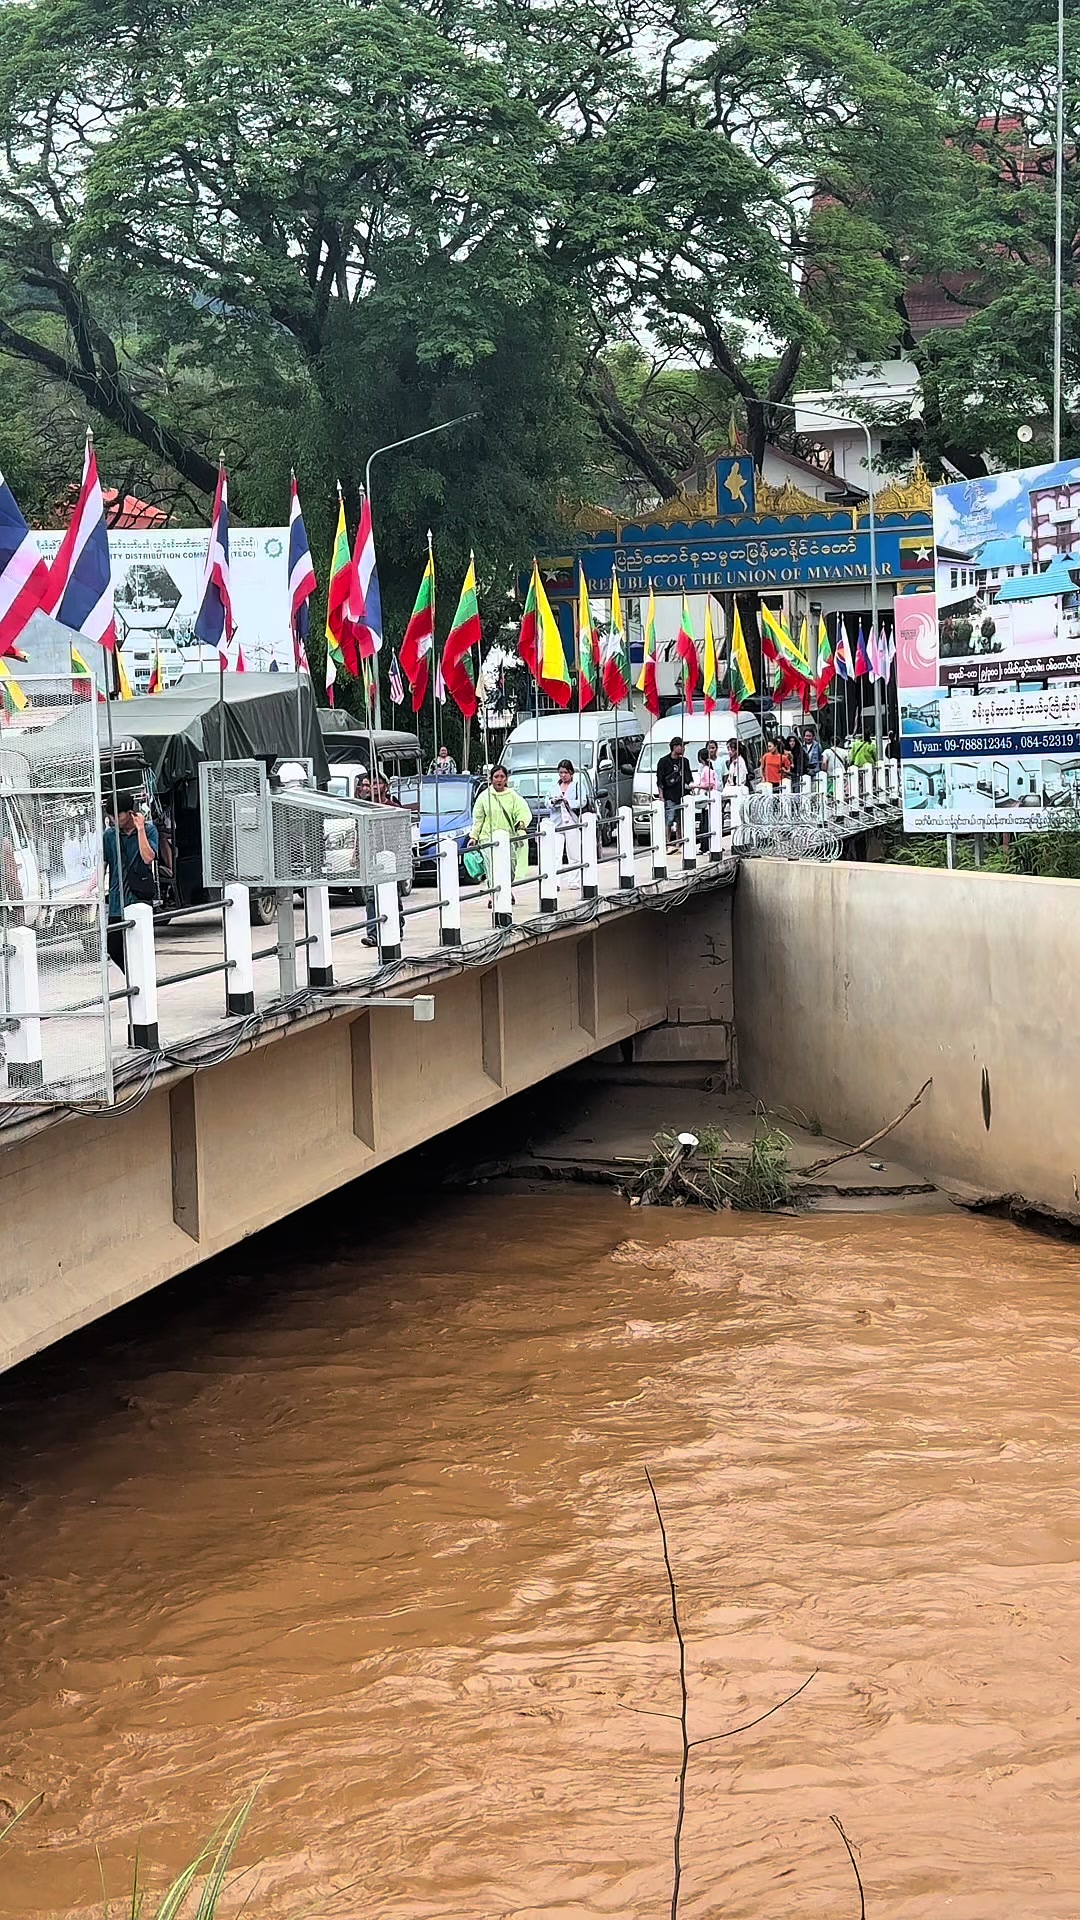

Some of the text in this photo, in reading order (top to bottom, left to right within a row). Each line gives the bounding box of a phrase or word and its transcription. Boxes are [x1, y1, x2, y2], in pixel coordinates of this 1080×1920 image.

[125, 552, 180, 560] DISTRIBUTION
[182, 551, 206, 559] COMM
[666, 574, 688, 587] OF
[691, 571, 723, 586] THE
[726, 568, 777, 584] UNION
[780, 567, 802, 580] OF
[912, 740, 942, 755] Myan:
[944, 736, 1013, 751] 09-788812345
[1020, 733, 1074, 748] 084-52319
